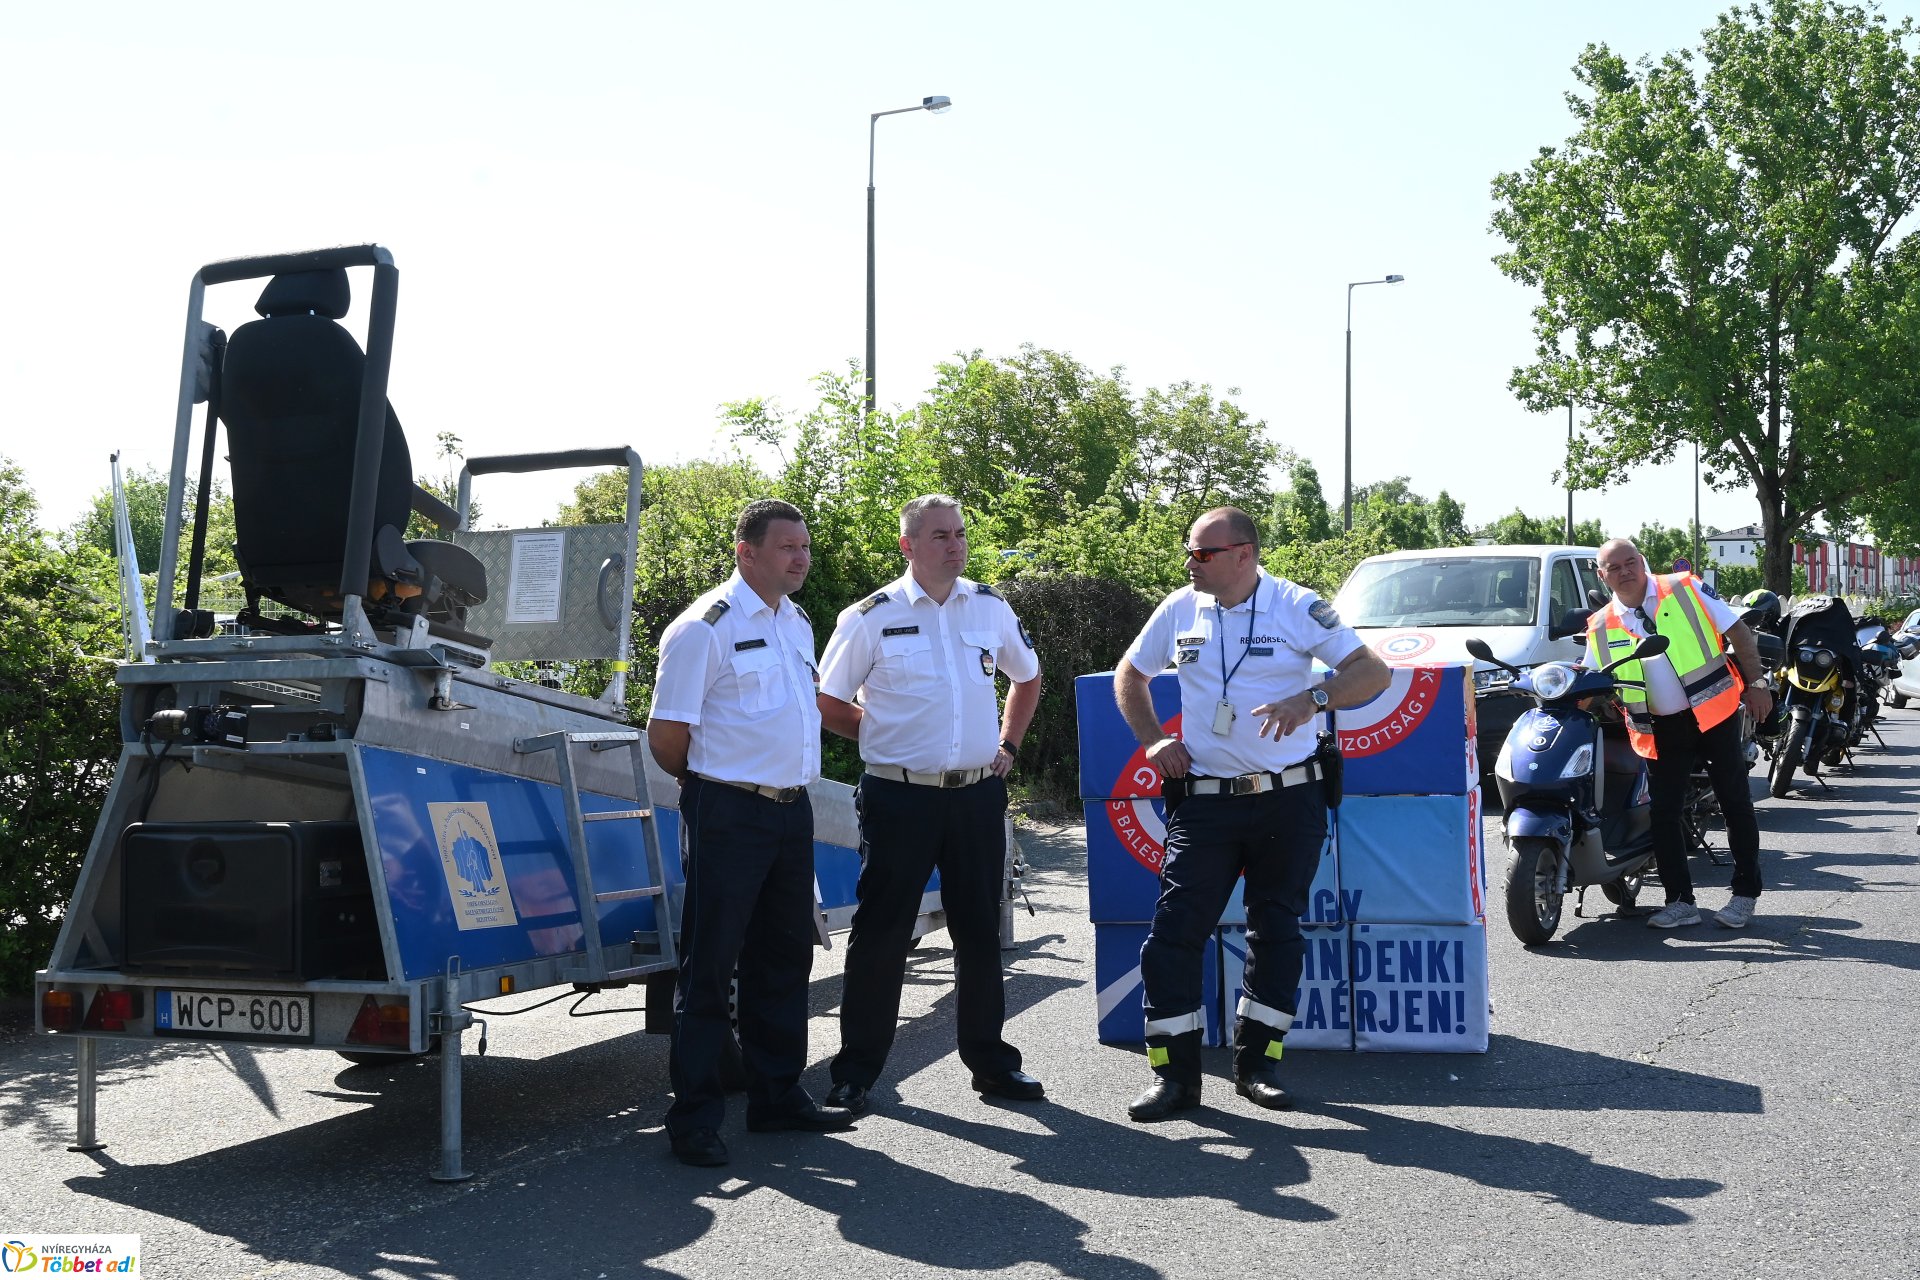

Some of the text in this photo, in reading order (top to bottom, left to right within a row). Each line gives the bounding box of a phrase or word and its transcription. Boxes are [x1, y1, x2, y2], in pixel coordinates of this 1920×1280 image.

[1338, 700, 1424, 751] IZOTTSÁG
[1303, 938, 1465, 984] INDENKI
[161, 995, 303, 1033] H WCP-600
